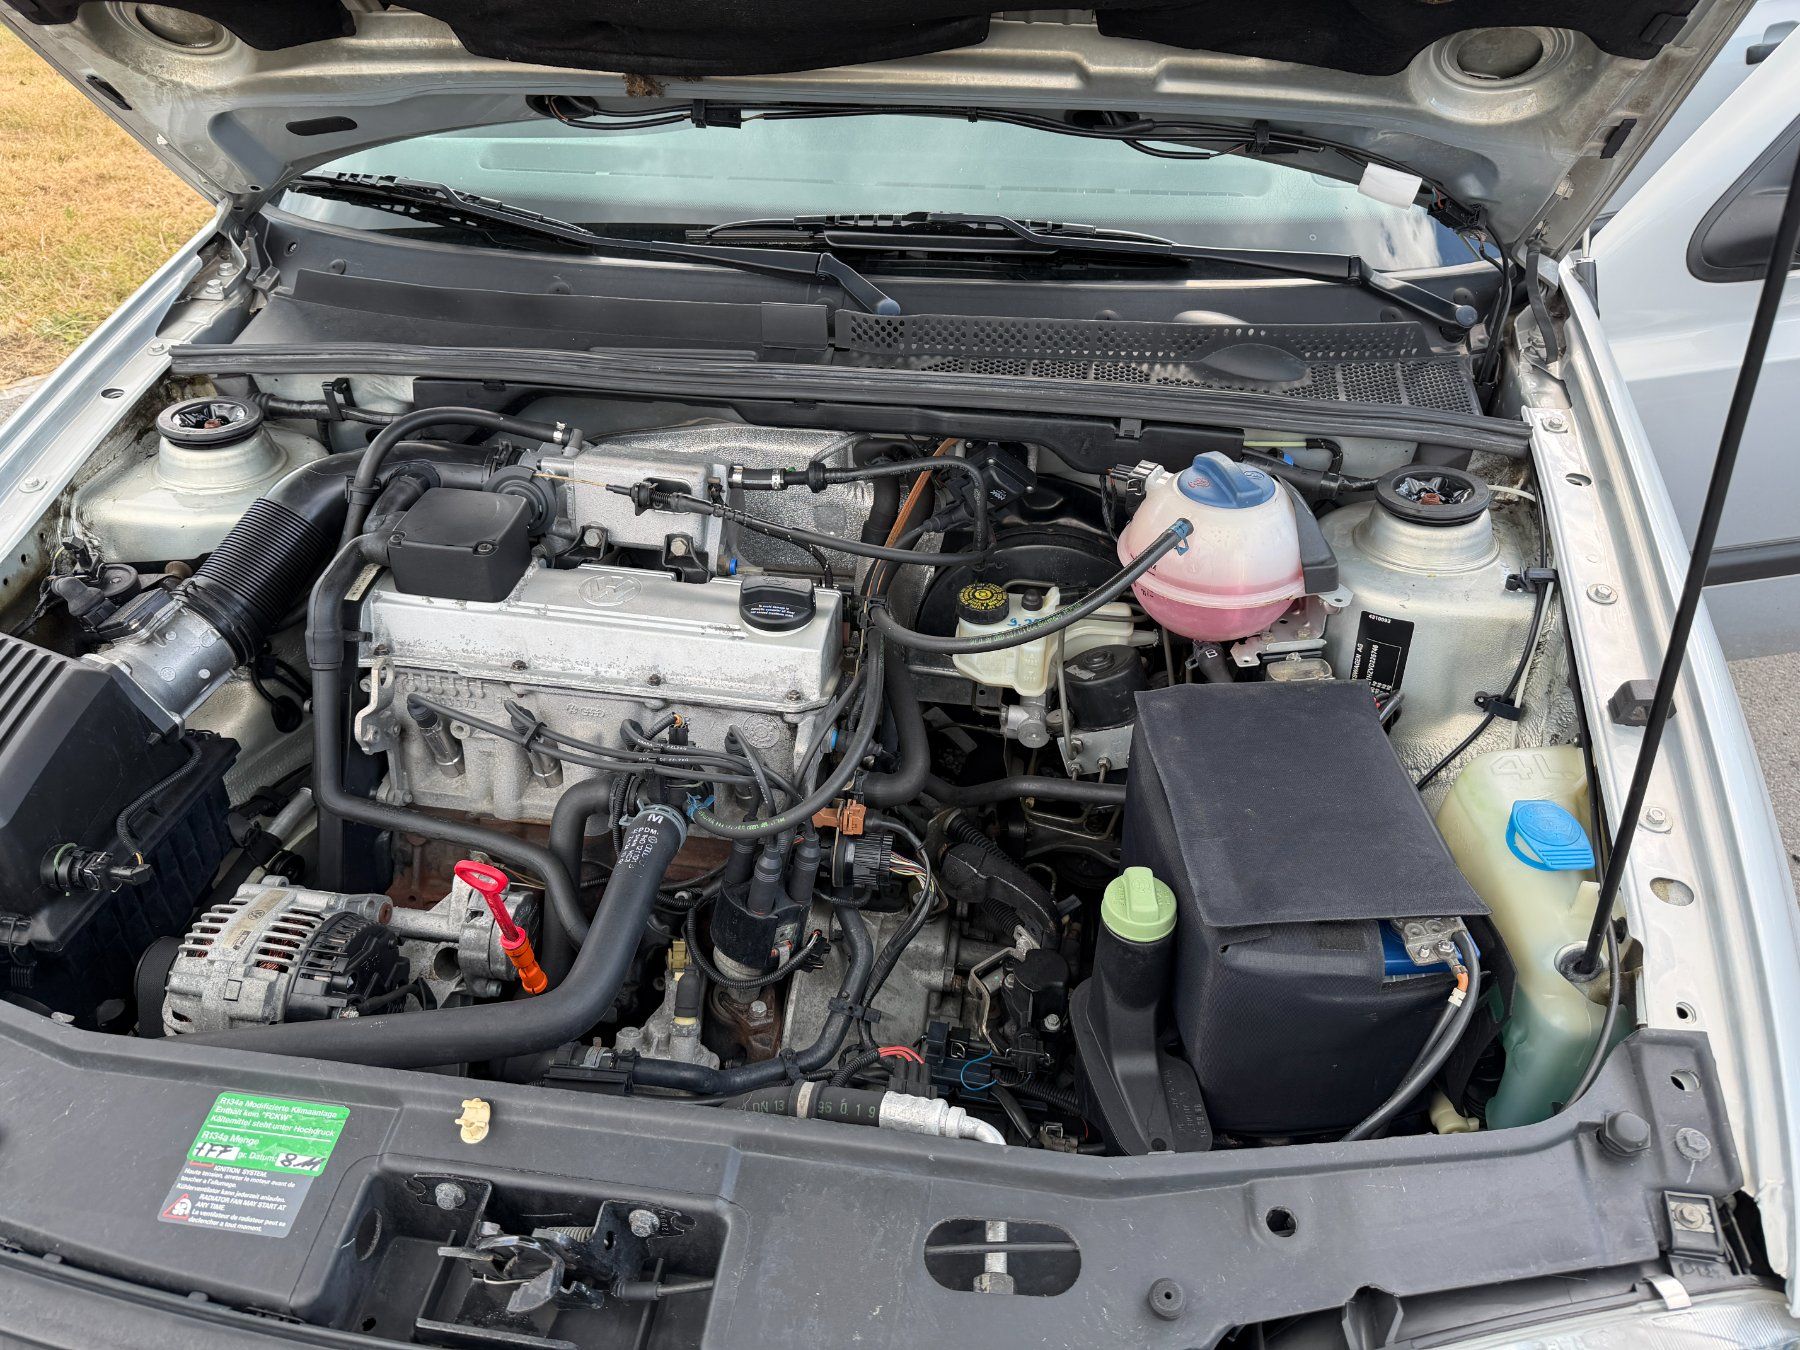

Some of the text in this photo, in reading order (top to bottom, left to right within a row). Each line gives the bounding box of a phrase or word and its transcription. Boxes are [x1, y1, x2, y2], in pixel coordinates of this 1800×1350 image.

[220, 1097, 243, 1107] R134a
[243, 1110, 259, 1118] kein
[201, 1130, 259, 1146] R134a Menge
